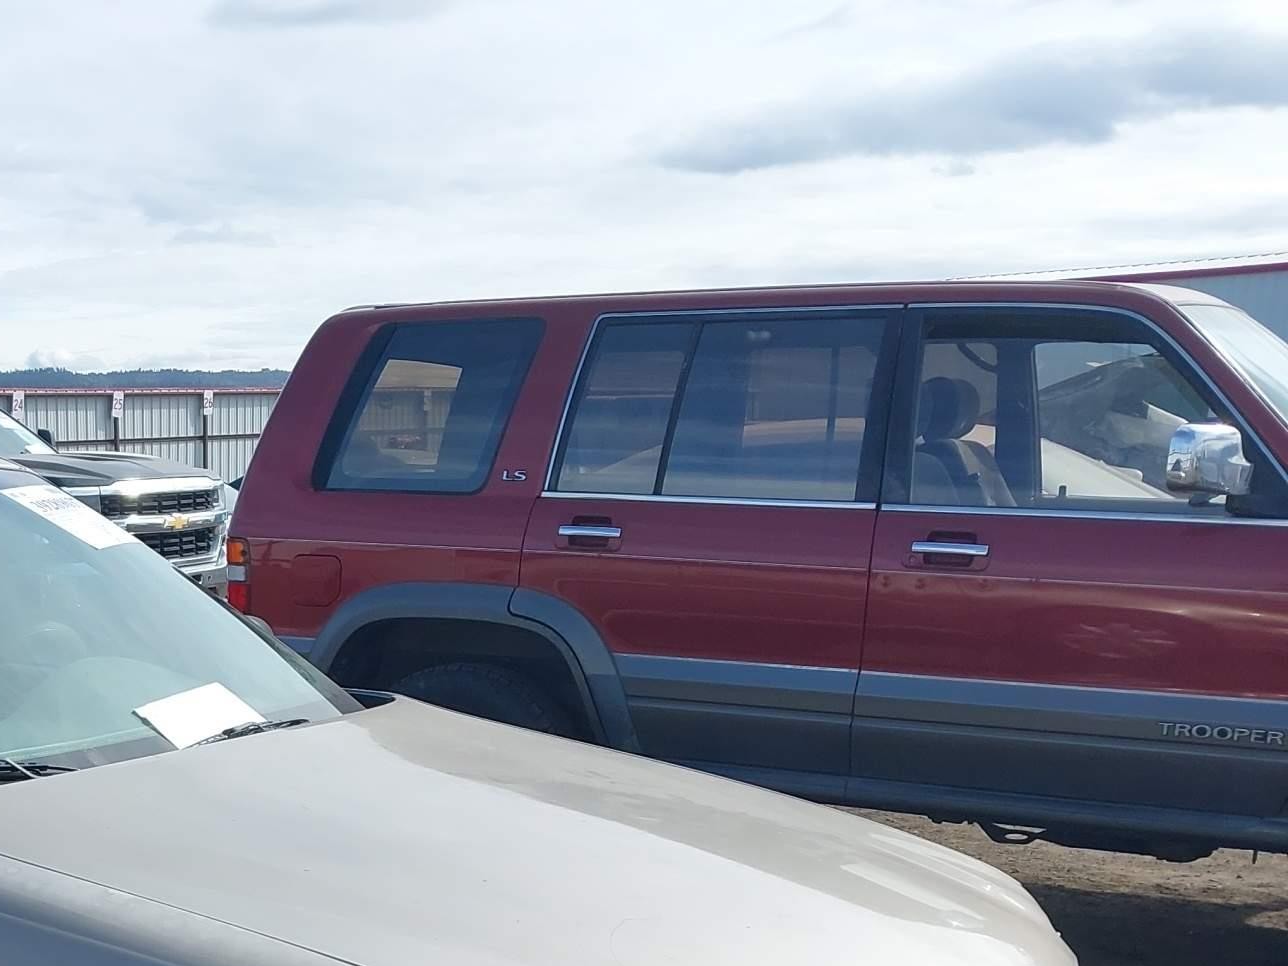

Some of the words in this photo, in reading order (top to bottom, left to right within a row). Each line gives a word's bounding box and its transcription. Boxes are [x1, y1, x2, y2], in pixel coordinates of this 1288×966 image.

[13, 398, 24, 411] 24
[113, 398, 123, 410] 25
[204, 397, 214, 408] 26
[502, 470, 527, 481] LS
[1158, 722, 1285, 745] TROOPER
